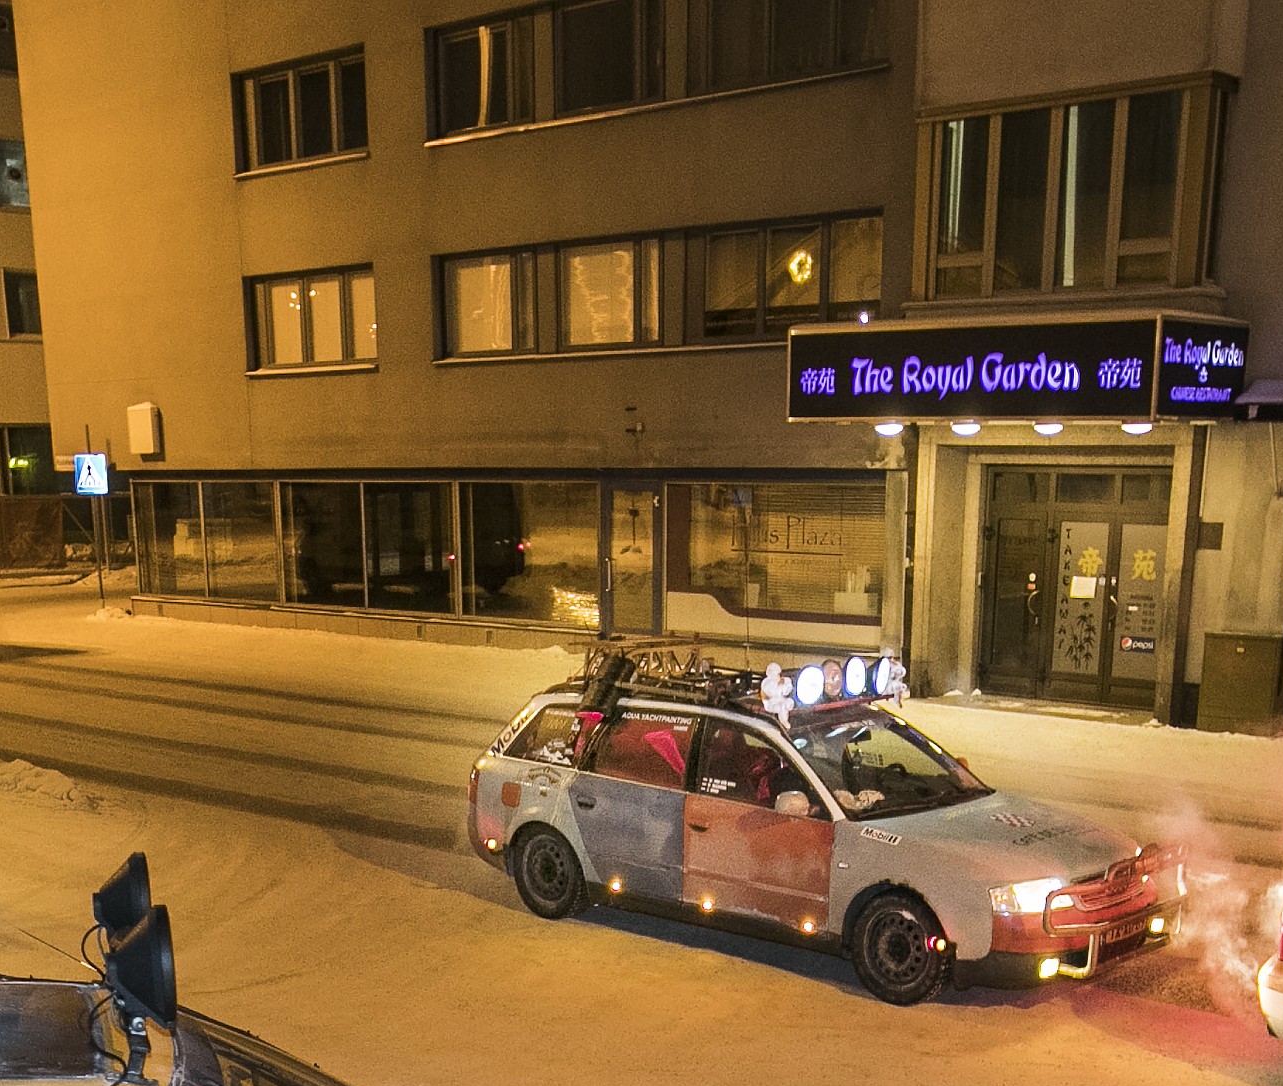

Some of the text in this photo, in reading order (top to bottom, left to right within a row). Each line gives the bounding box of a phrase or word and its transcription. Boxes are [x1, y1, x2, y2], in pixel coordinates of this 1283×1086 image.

[1163, 336, 1245, 371] The Royal Garden
[850, 351, 1081, 401] The Royal Garden
